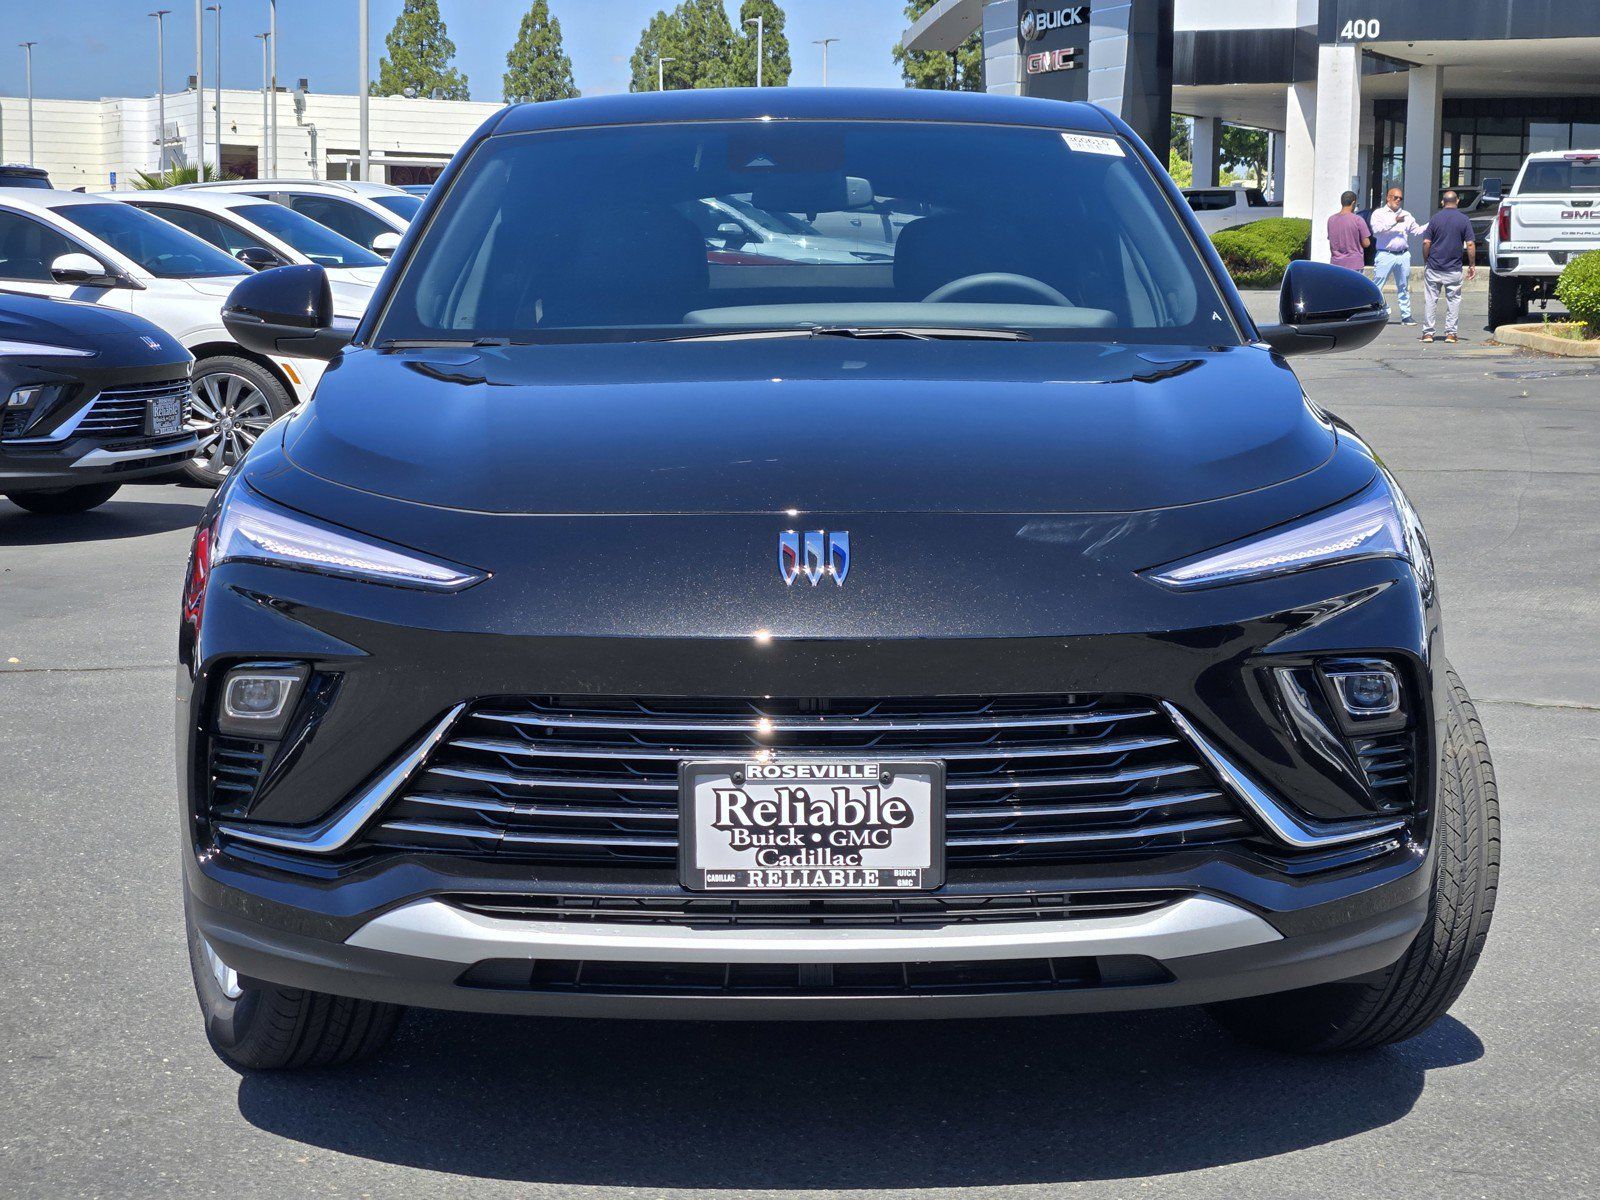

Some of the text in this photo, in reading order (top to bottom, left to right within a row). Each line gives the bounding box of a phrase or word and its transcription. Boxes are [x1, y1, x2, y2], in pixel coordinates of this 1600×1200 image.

[1036, 6, 1083, 31] BUICK
[1340, 19, 1380, 39] 400
[1026, 47, 1075, 74] GMC
[1561, 210, 1600, 219] GMC
[747, 765, 877, 778] ROSEVILLE
[714, 786, 909, 828] Reliable
[732, 828, 890, 846] Buick GMC
[757, 848, 859, 867] Cadillac
[706, 874, 736, 883] CADILLAC
[747, 870, 879, 887] RELIABLE
[893, 869, 917, 877] BUICK
[896, 879, 914, 887] GMC
